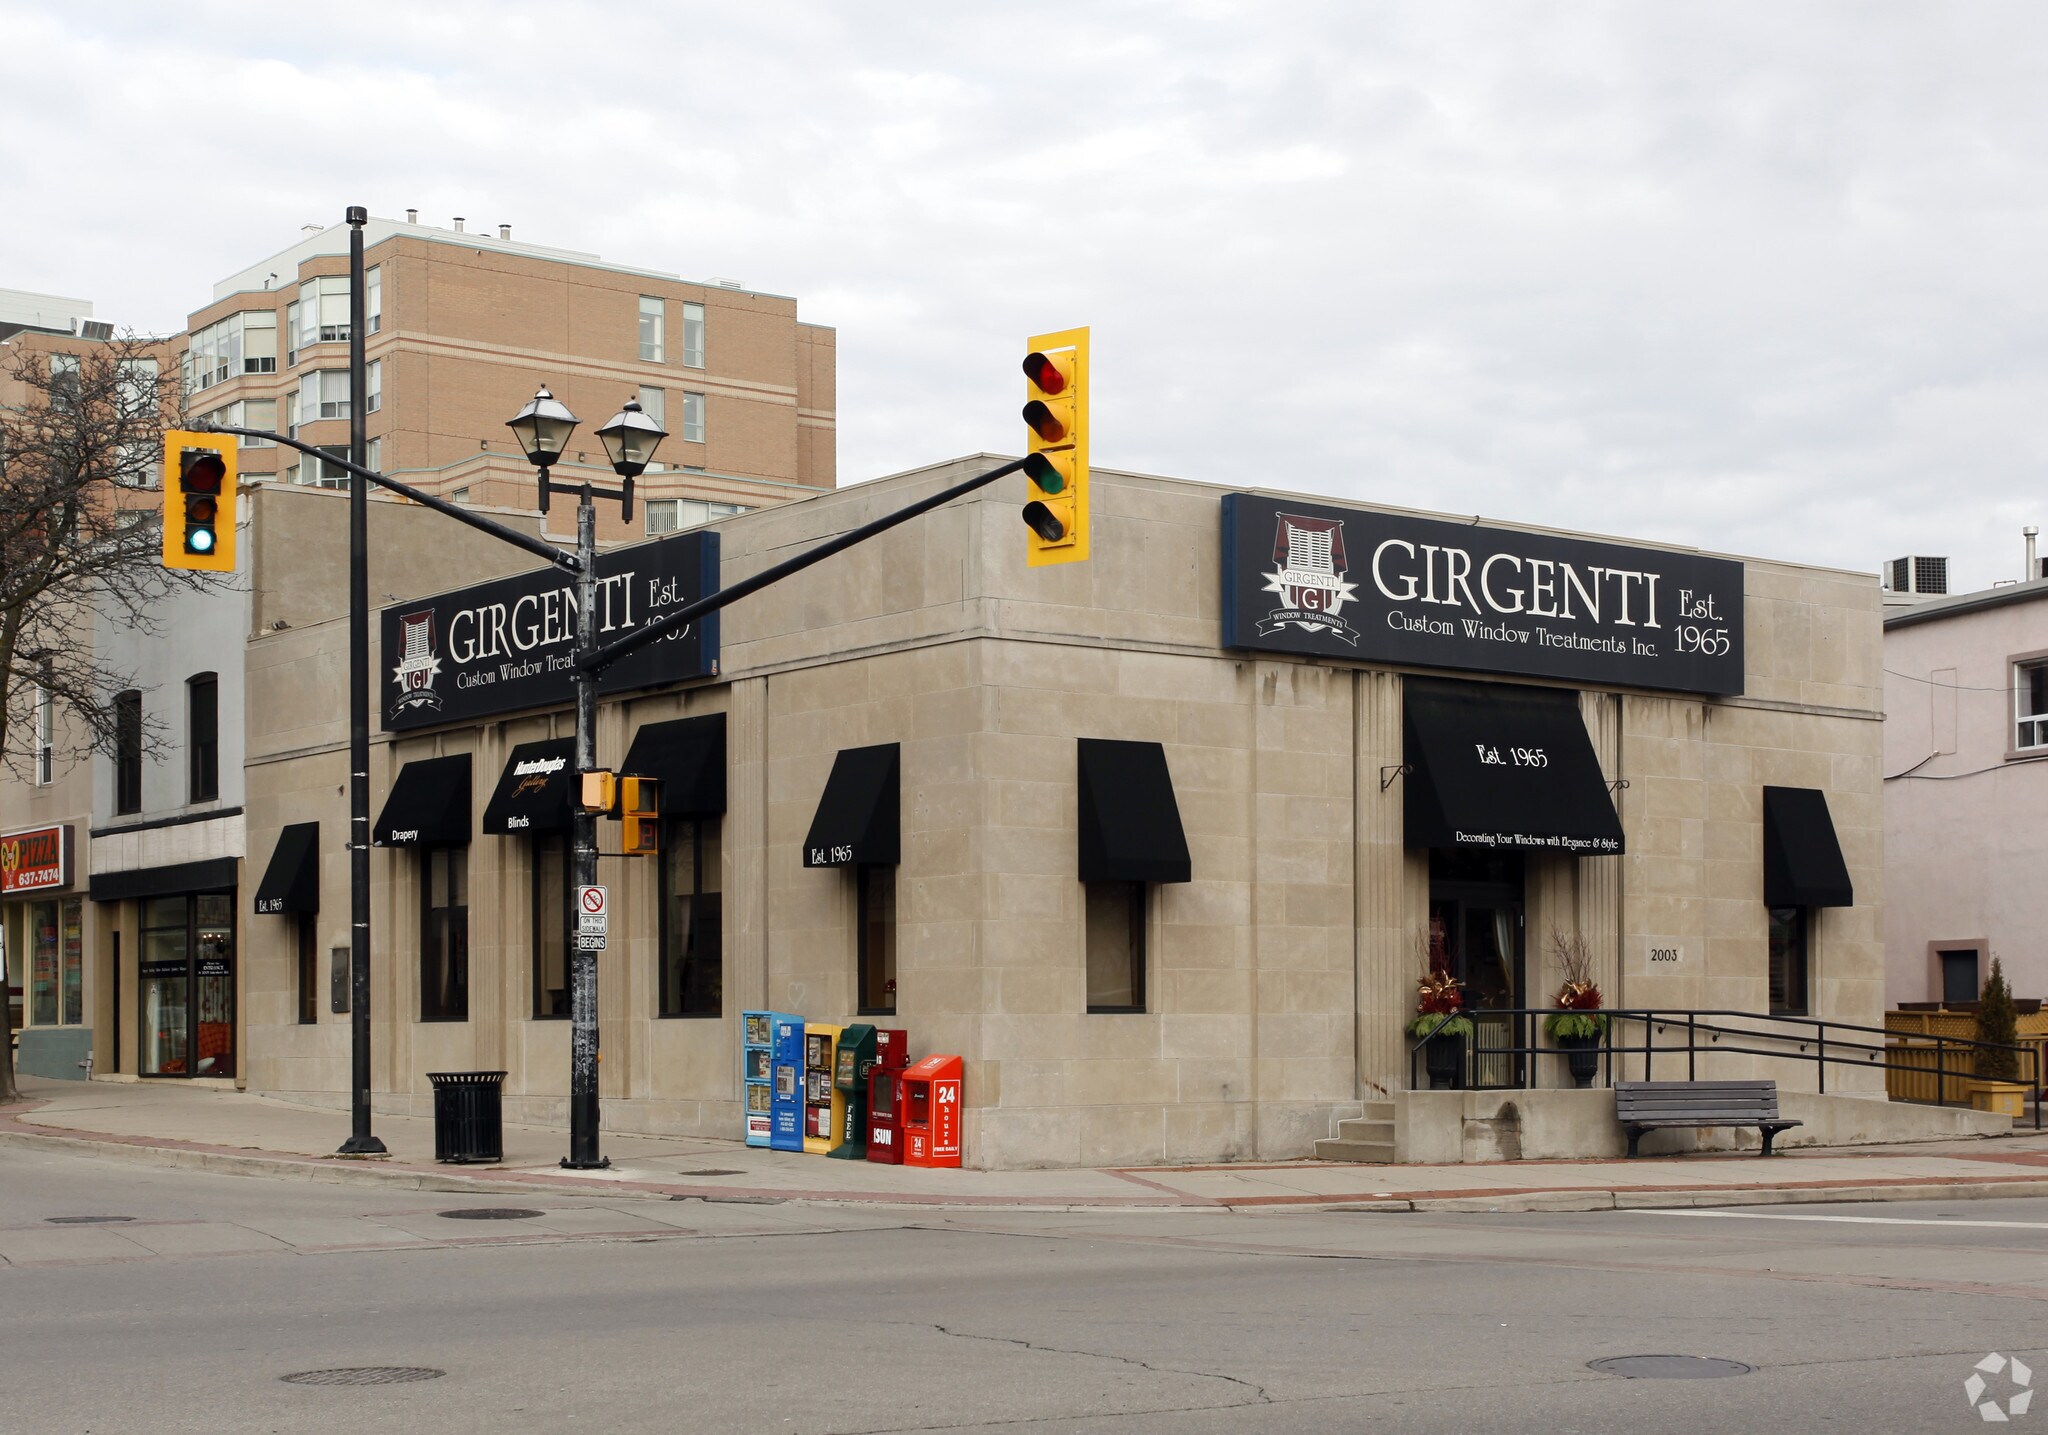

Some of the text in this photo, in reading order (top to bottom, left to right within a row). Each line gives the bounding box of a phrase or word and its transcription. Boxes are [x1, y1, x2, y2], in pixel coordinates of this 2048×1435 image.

[1284, 571, 1335, 587] GIRGENTI
[1372, 539, 1662, 629] GIRGENTI
[649, 576, 685, 608] Est.
[1302, 588, 1318, 610] G
[1679, 589, 1723, 621] Est.
[1273, 611, 1343, 629] WINDOW TREATMENTS
[1387, 610, 1659, 657] Custom Window Treatments Inc.
[1674, 625, 1731, 656] 1965
[412, 671, 421, 689] G
[457, 671, 496, 689] Custom
[500, 659, 543, 681] Window
[1475, 744, 1548, 768] Est. 1965
[508, 815, 529, 828] Blinds
[392, 830, 419, 842] Drapery
[1456, 831, 1619, 851] Decorating Your Windows with Elegance & Style
[2, 848, 8, 866] 2
[19, 834, 59, 869] PIZZA
[811, 845, 852, 864] Est. 1965
[259, 897, 283, 912] Est. 1965
[581, 937, 605, 948] BEGINS
[1651, 949, 1678, 961] 2003
[938, 1086, 955, 1103] 24
[845, 1105, 853, 1139] FREE
[914, 1138, 922, 1148] 24
